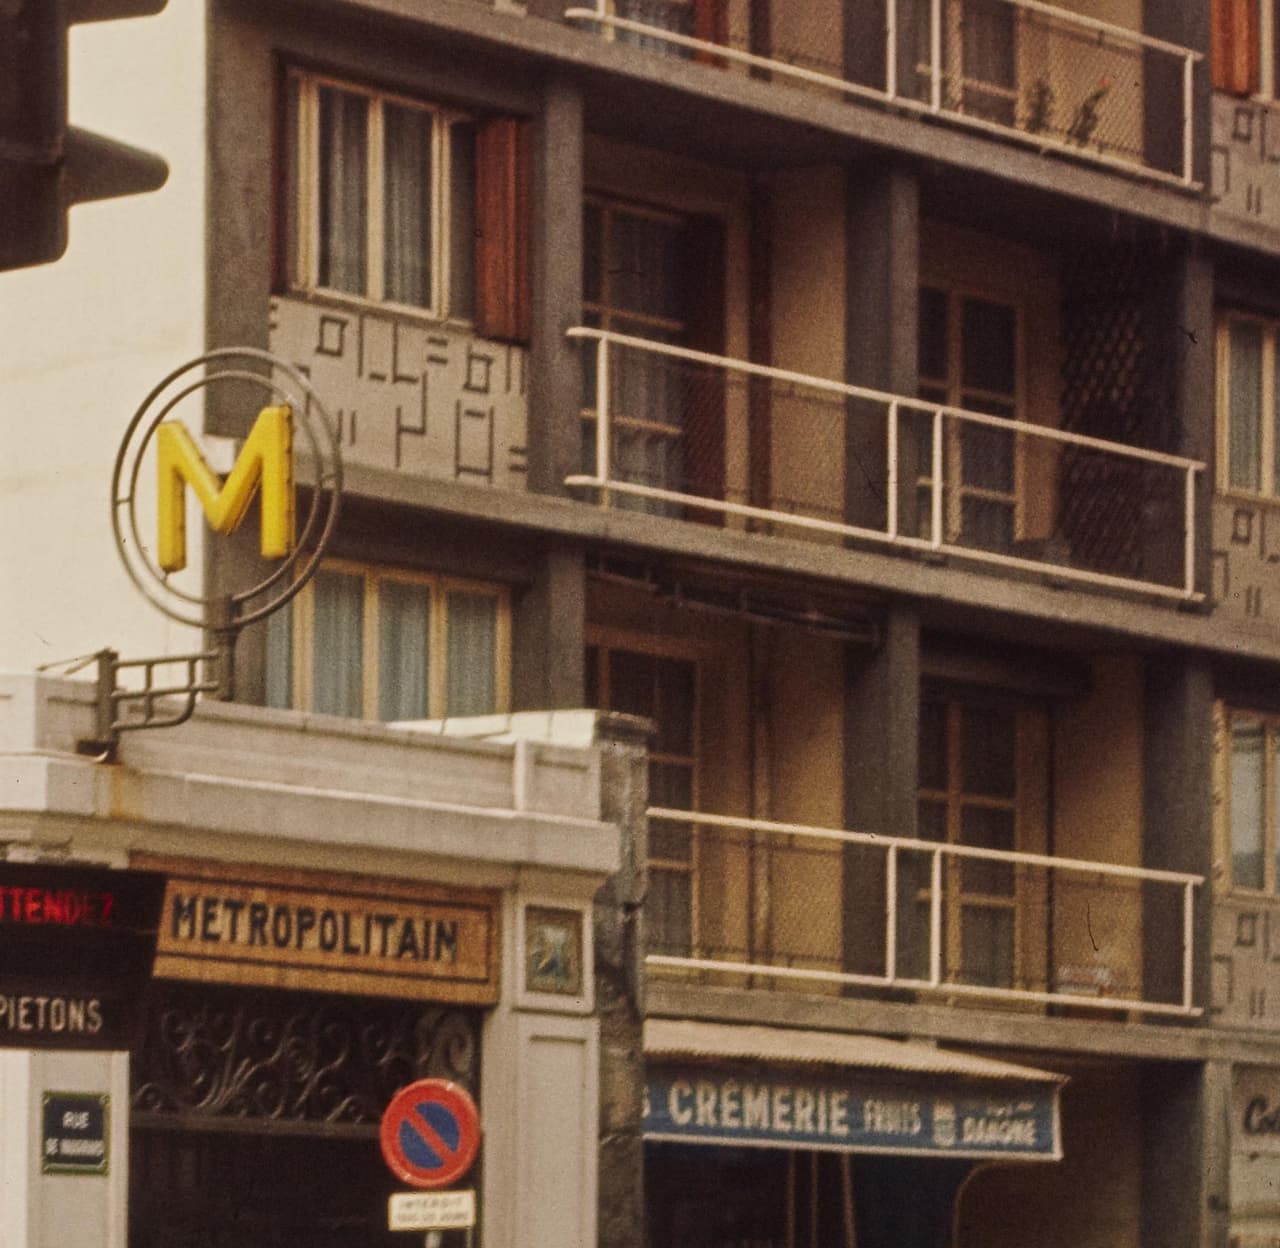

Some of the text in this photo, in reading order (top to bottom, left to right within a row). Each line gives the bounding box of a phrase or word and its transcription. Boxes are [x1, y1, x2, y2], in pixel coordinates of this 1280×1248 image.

[156, 403, 296, 573] M
[171, 894, 458, 962] METROPOLITAIN
[62, 1111, 89, 1129] RUE
